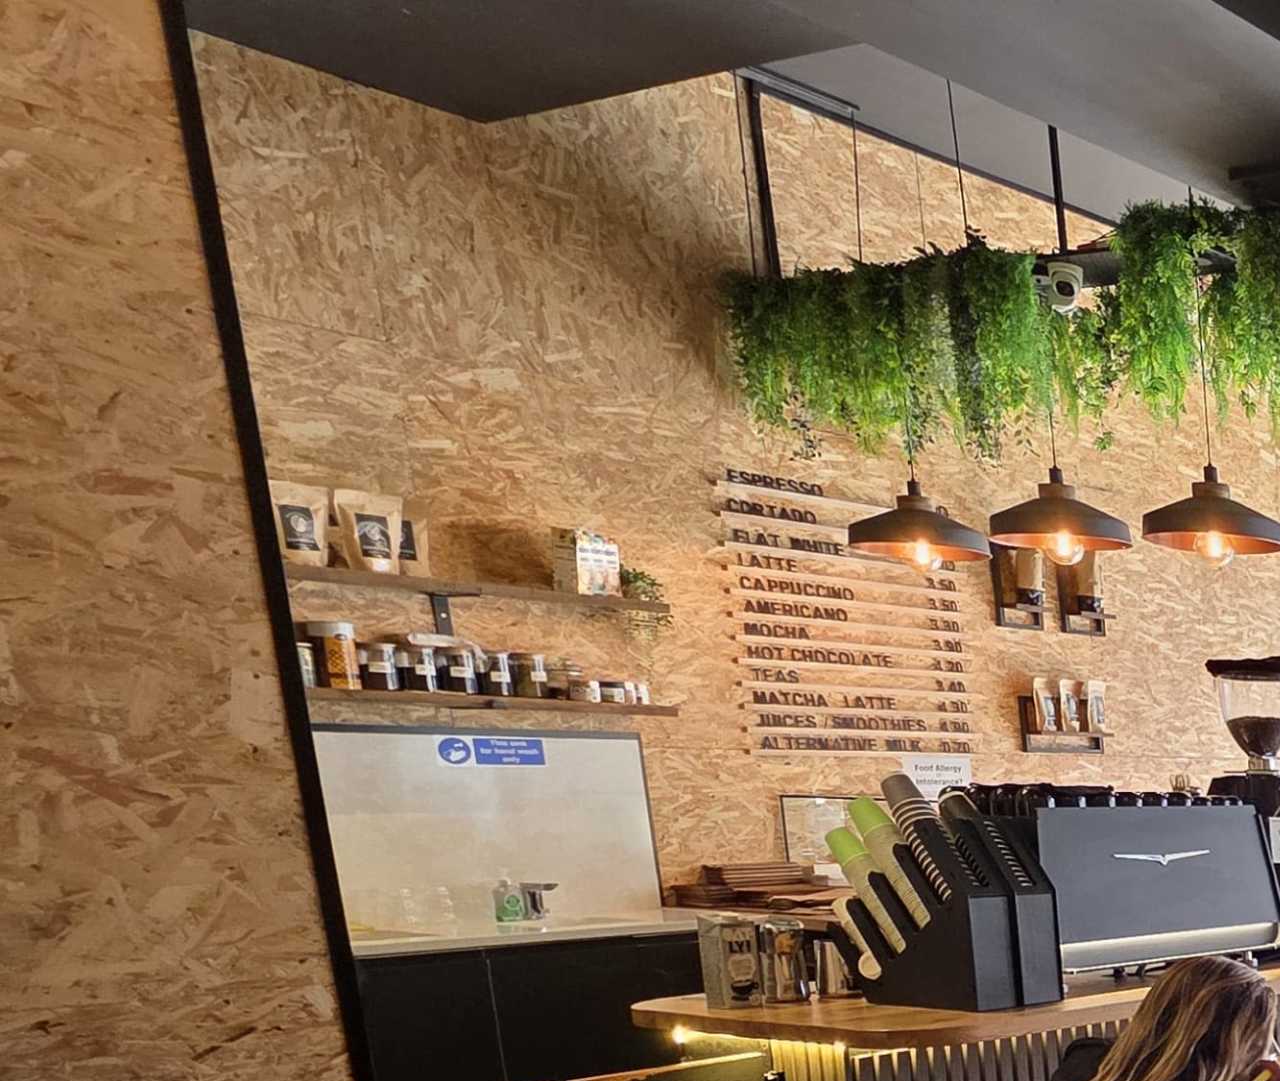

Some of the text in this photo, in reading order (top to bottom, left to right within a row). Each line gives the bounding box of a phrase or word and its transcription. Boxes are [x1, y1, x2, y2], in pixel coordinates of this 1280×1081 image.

[725, 468, 824, 496] ESPRESSO
[725, 498, 817, 524] CORTADO
[732, 528, 845, 556] FLAT WHITE
[737, 553, 798, 572] LATTE
[739, 575, 855, 601] CAPPUCCINO
[743, 599, 848, 622] AMERICANO
[743, 622, 811, 640] MOCHA
[746, 645, 785, 660] HOT
[791, 648, 894, 668] CHOCOLATE
[751, 667, 800, 684] TEAS
[752, 690, 829, 708] MATCHA
[842, 695, 897, 710] LATTE
[757, 714, 817, 728] JUICES
[761, 736, 878, 751] ALTERNATIVE
[885, 739, 923, 752] MILK
[914, 764, 962, 773] Food Allergy
